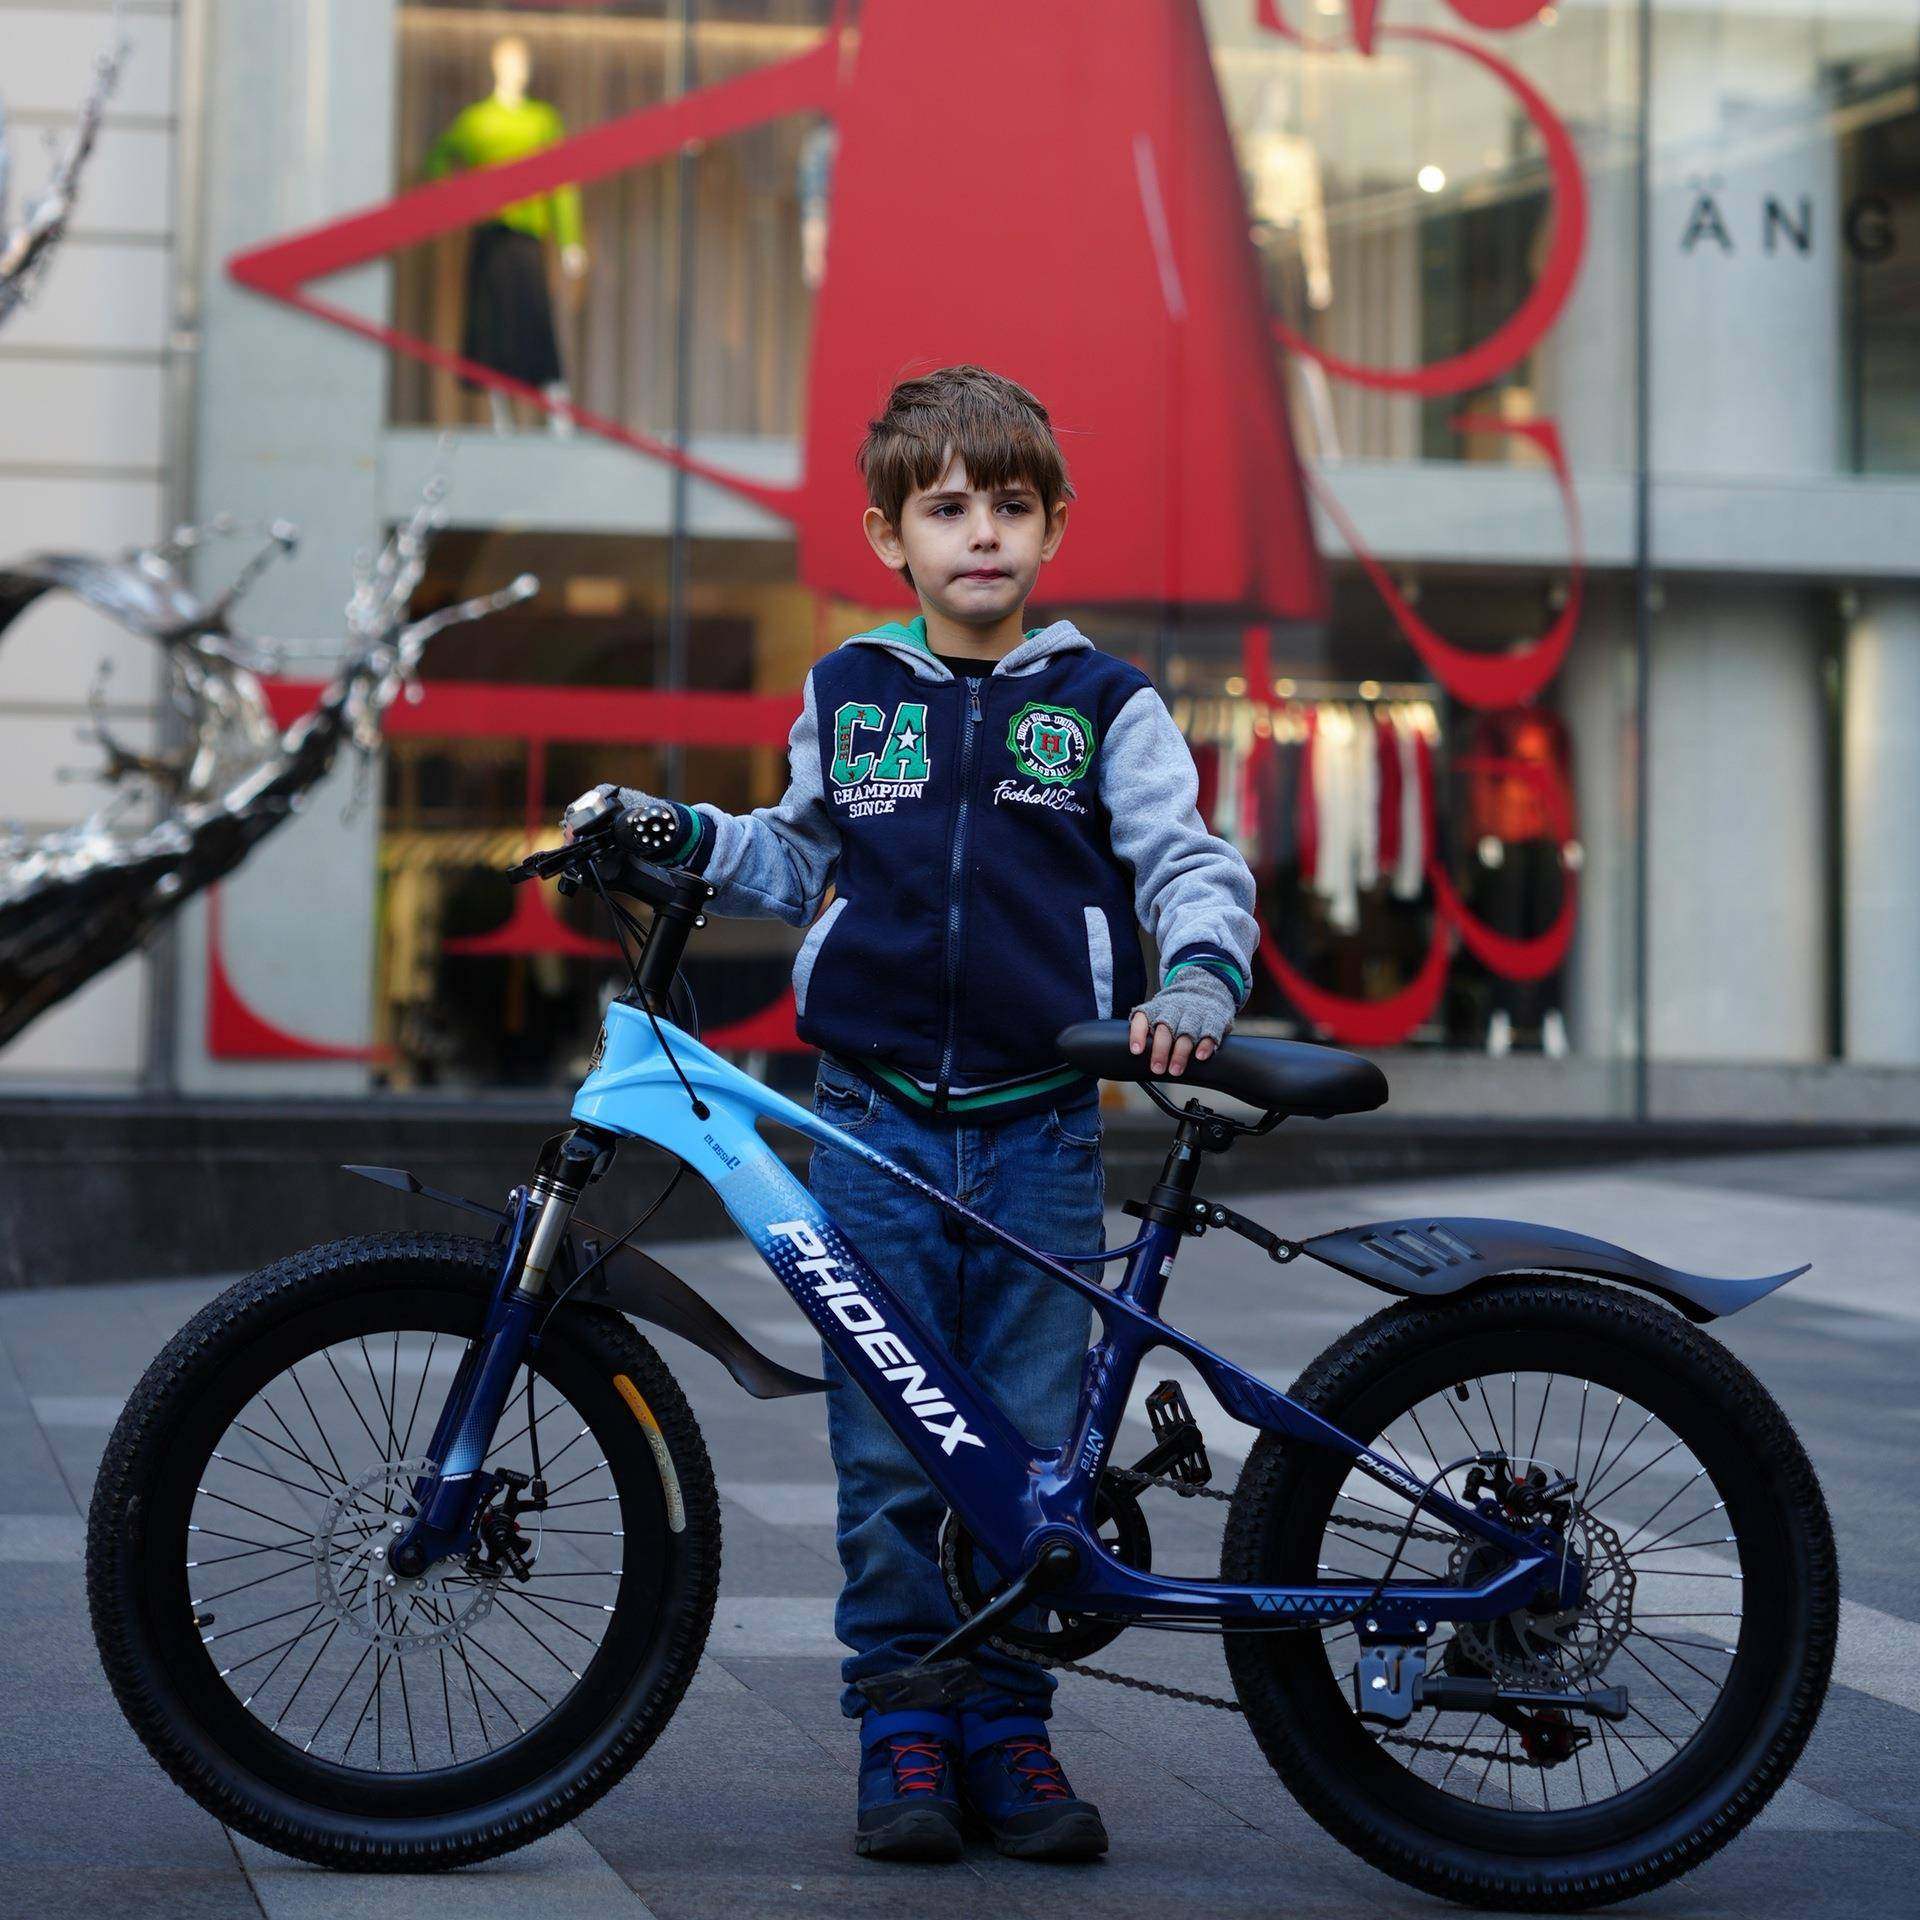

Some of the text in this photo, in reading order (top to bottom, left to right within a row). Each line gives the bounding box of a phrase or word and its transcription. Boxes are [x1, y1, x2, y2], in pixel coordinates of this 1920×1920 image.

[830, 701, 931, 788] CA
[1025, 757, 1072, 777] BASEBALL
[833, 782, 924, 805] CHAMPION
[993, 780, 1058, 807] Football
[848, 799, 896, 819] SINCE
[766, 1219, 986, 1457] PHOENIX
